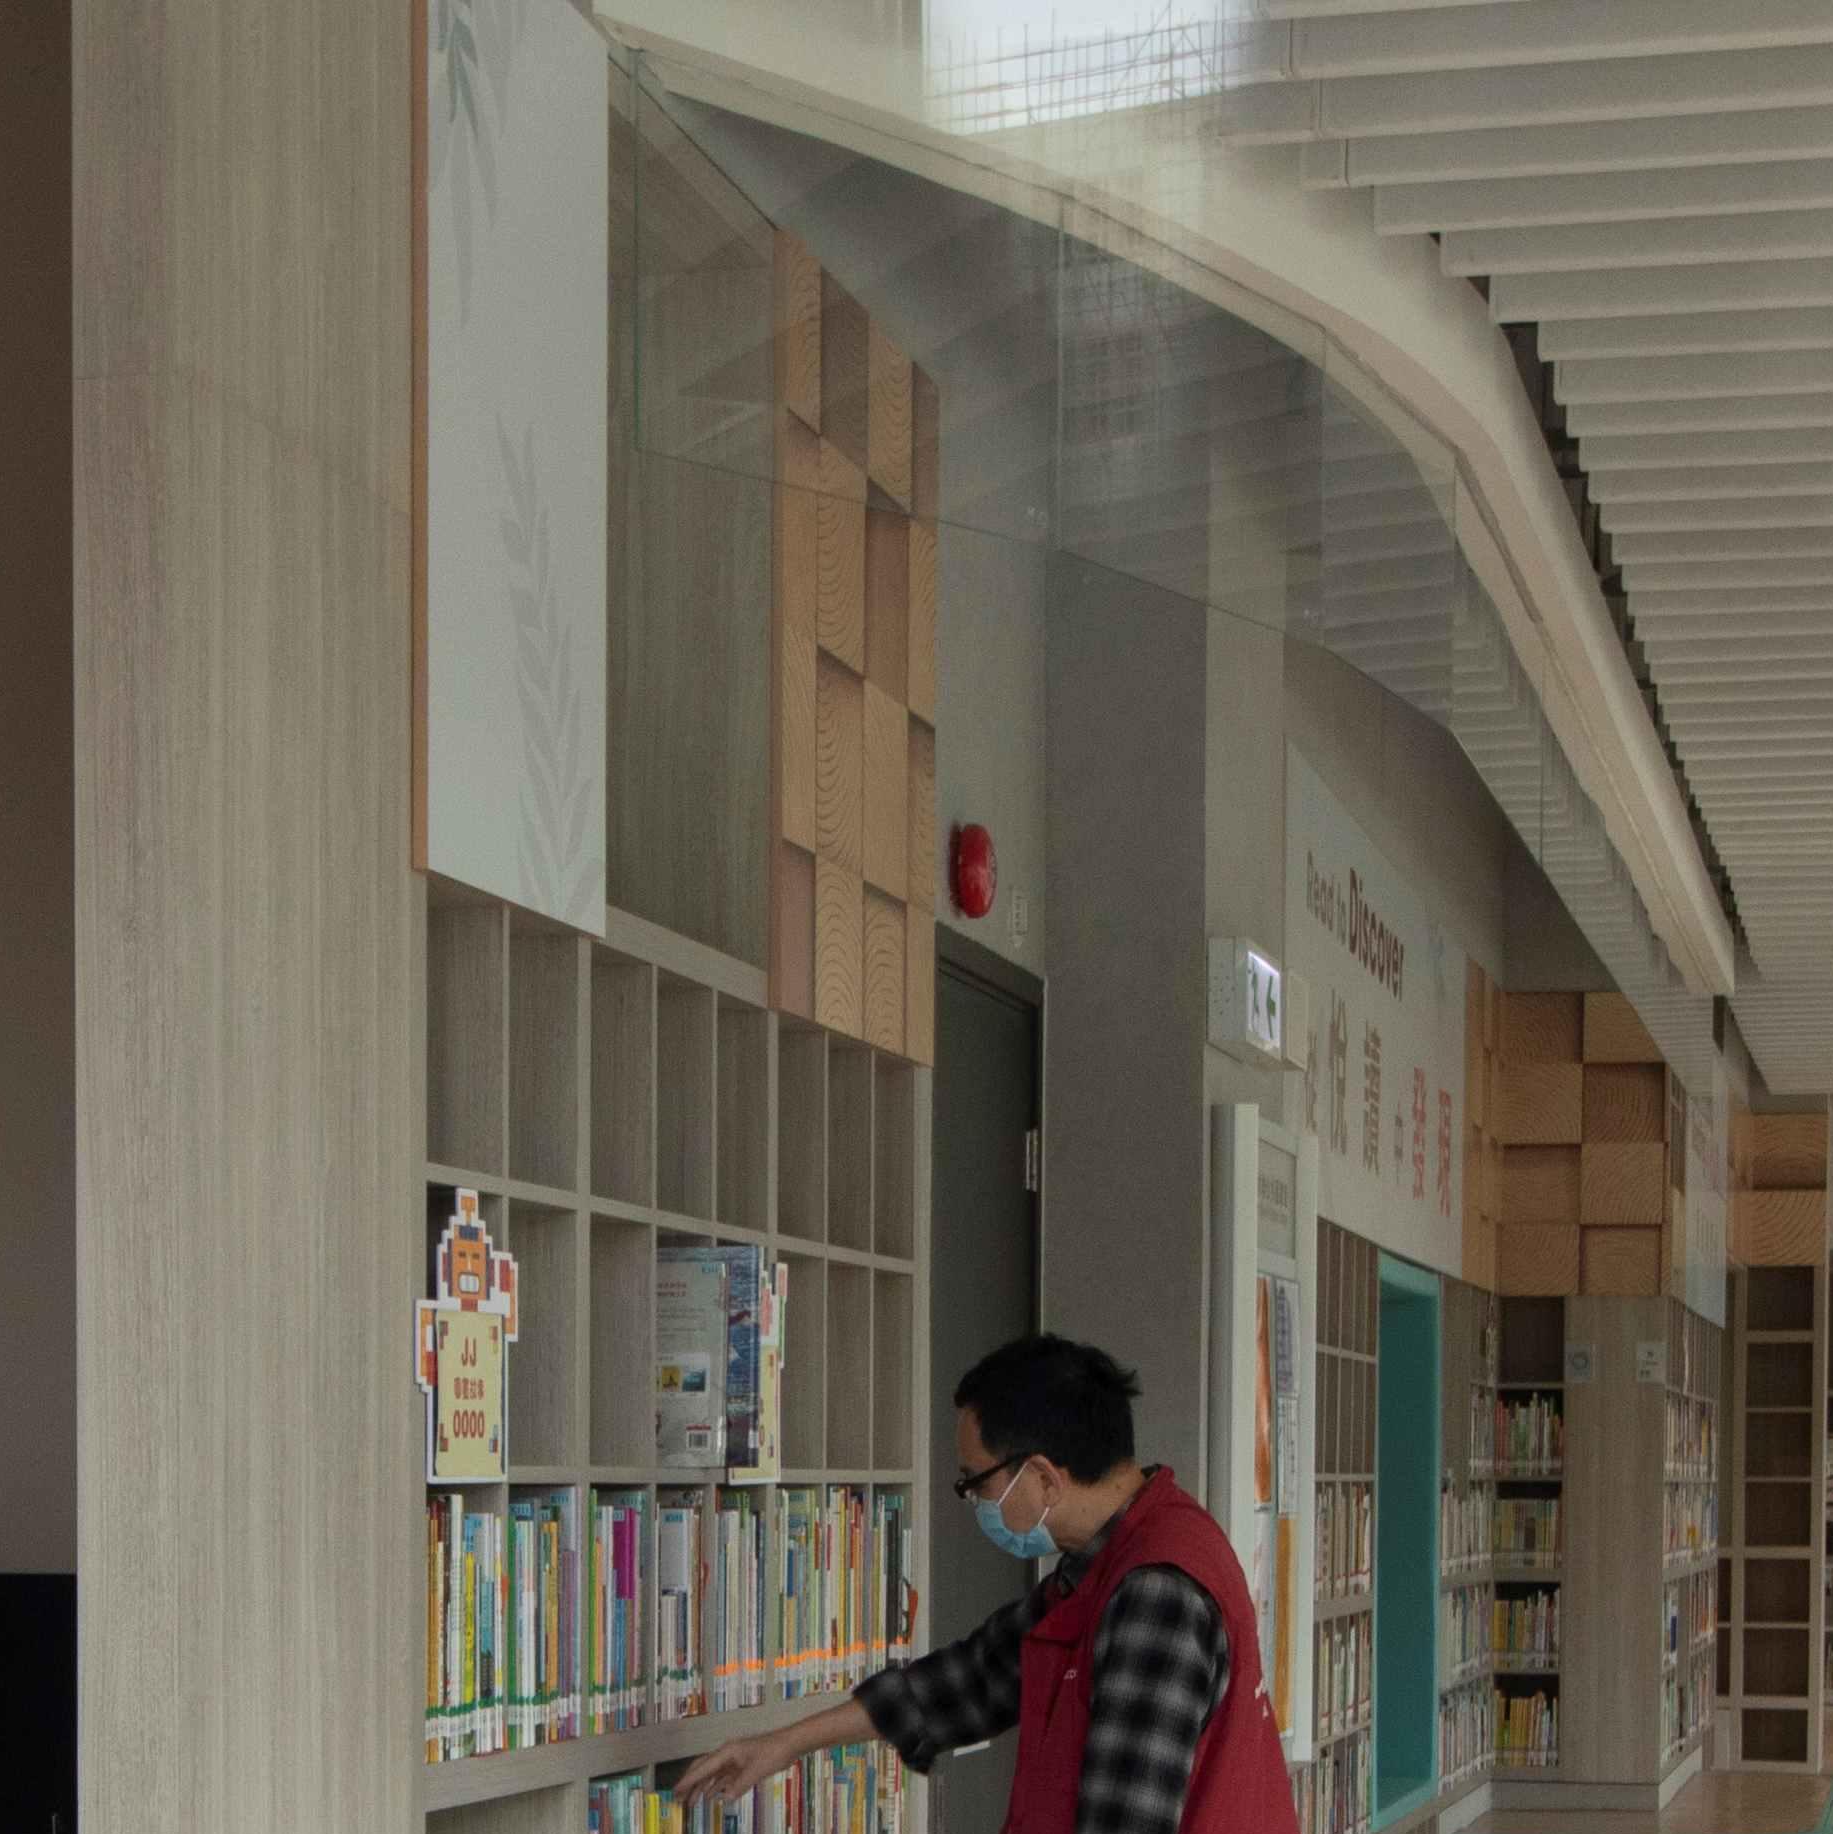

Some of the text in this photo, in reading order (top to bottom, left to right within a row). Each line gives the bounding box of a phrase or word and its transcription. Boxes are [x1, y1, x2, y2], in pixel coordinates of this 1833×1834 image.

[1349, 866, 1405, 1003] Discover
[460, 1336, 477, 1367] JJ
[452, 1409, 486, 1439] 0000
